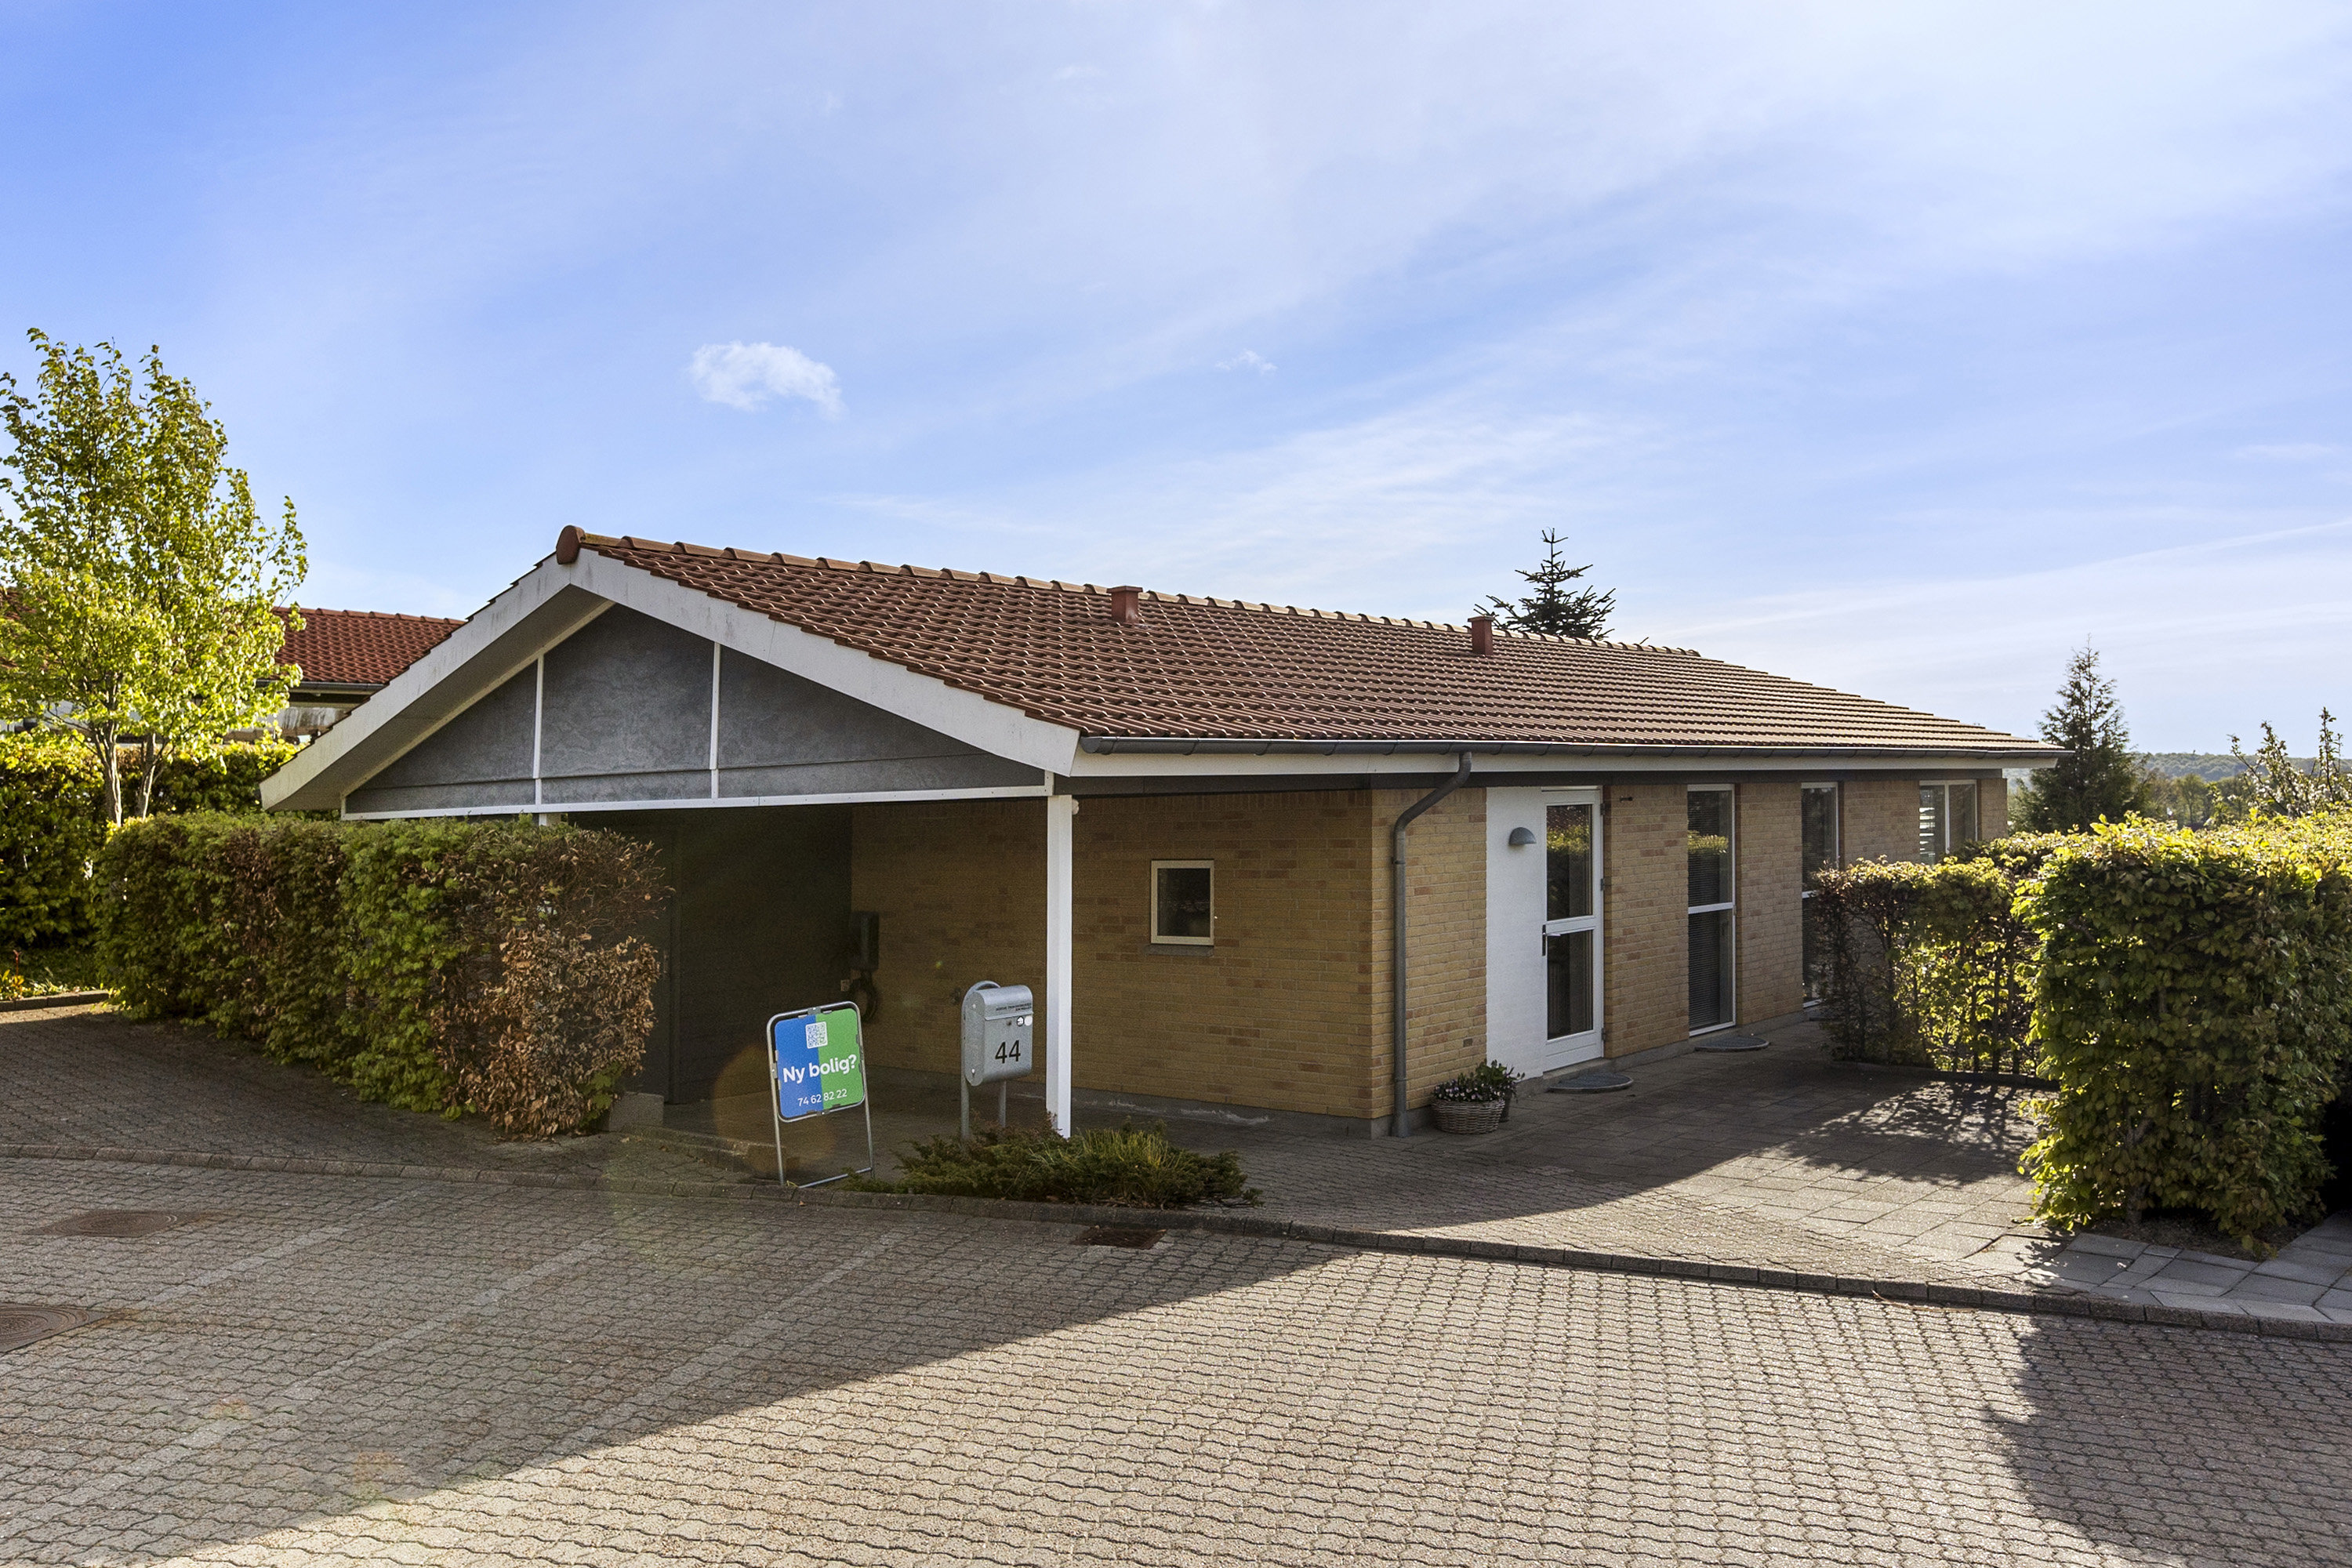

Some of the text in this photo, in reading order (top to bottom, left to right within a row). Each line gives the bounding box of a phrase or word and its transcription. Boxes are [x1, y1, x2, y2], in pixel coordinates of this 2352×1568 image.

[995, 1040, 1021, 1063] 44
[782, 1054, 857, 1083] Ny bolig?
[797, 1088, 848, 1106] 74 62 82 22
